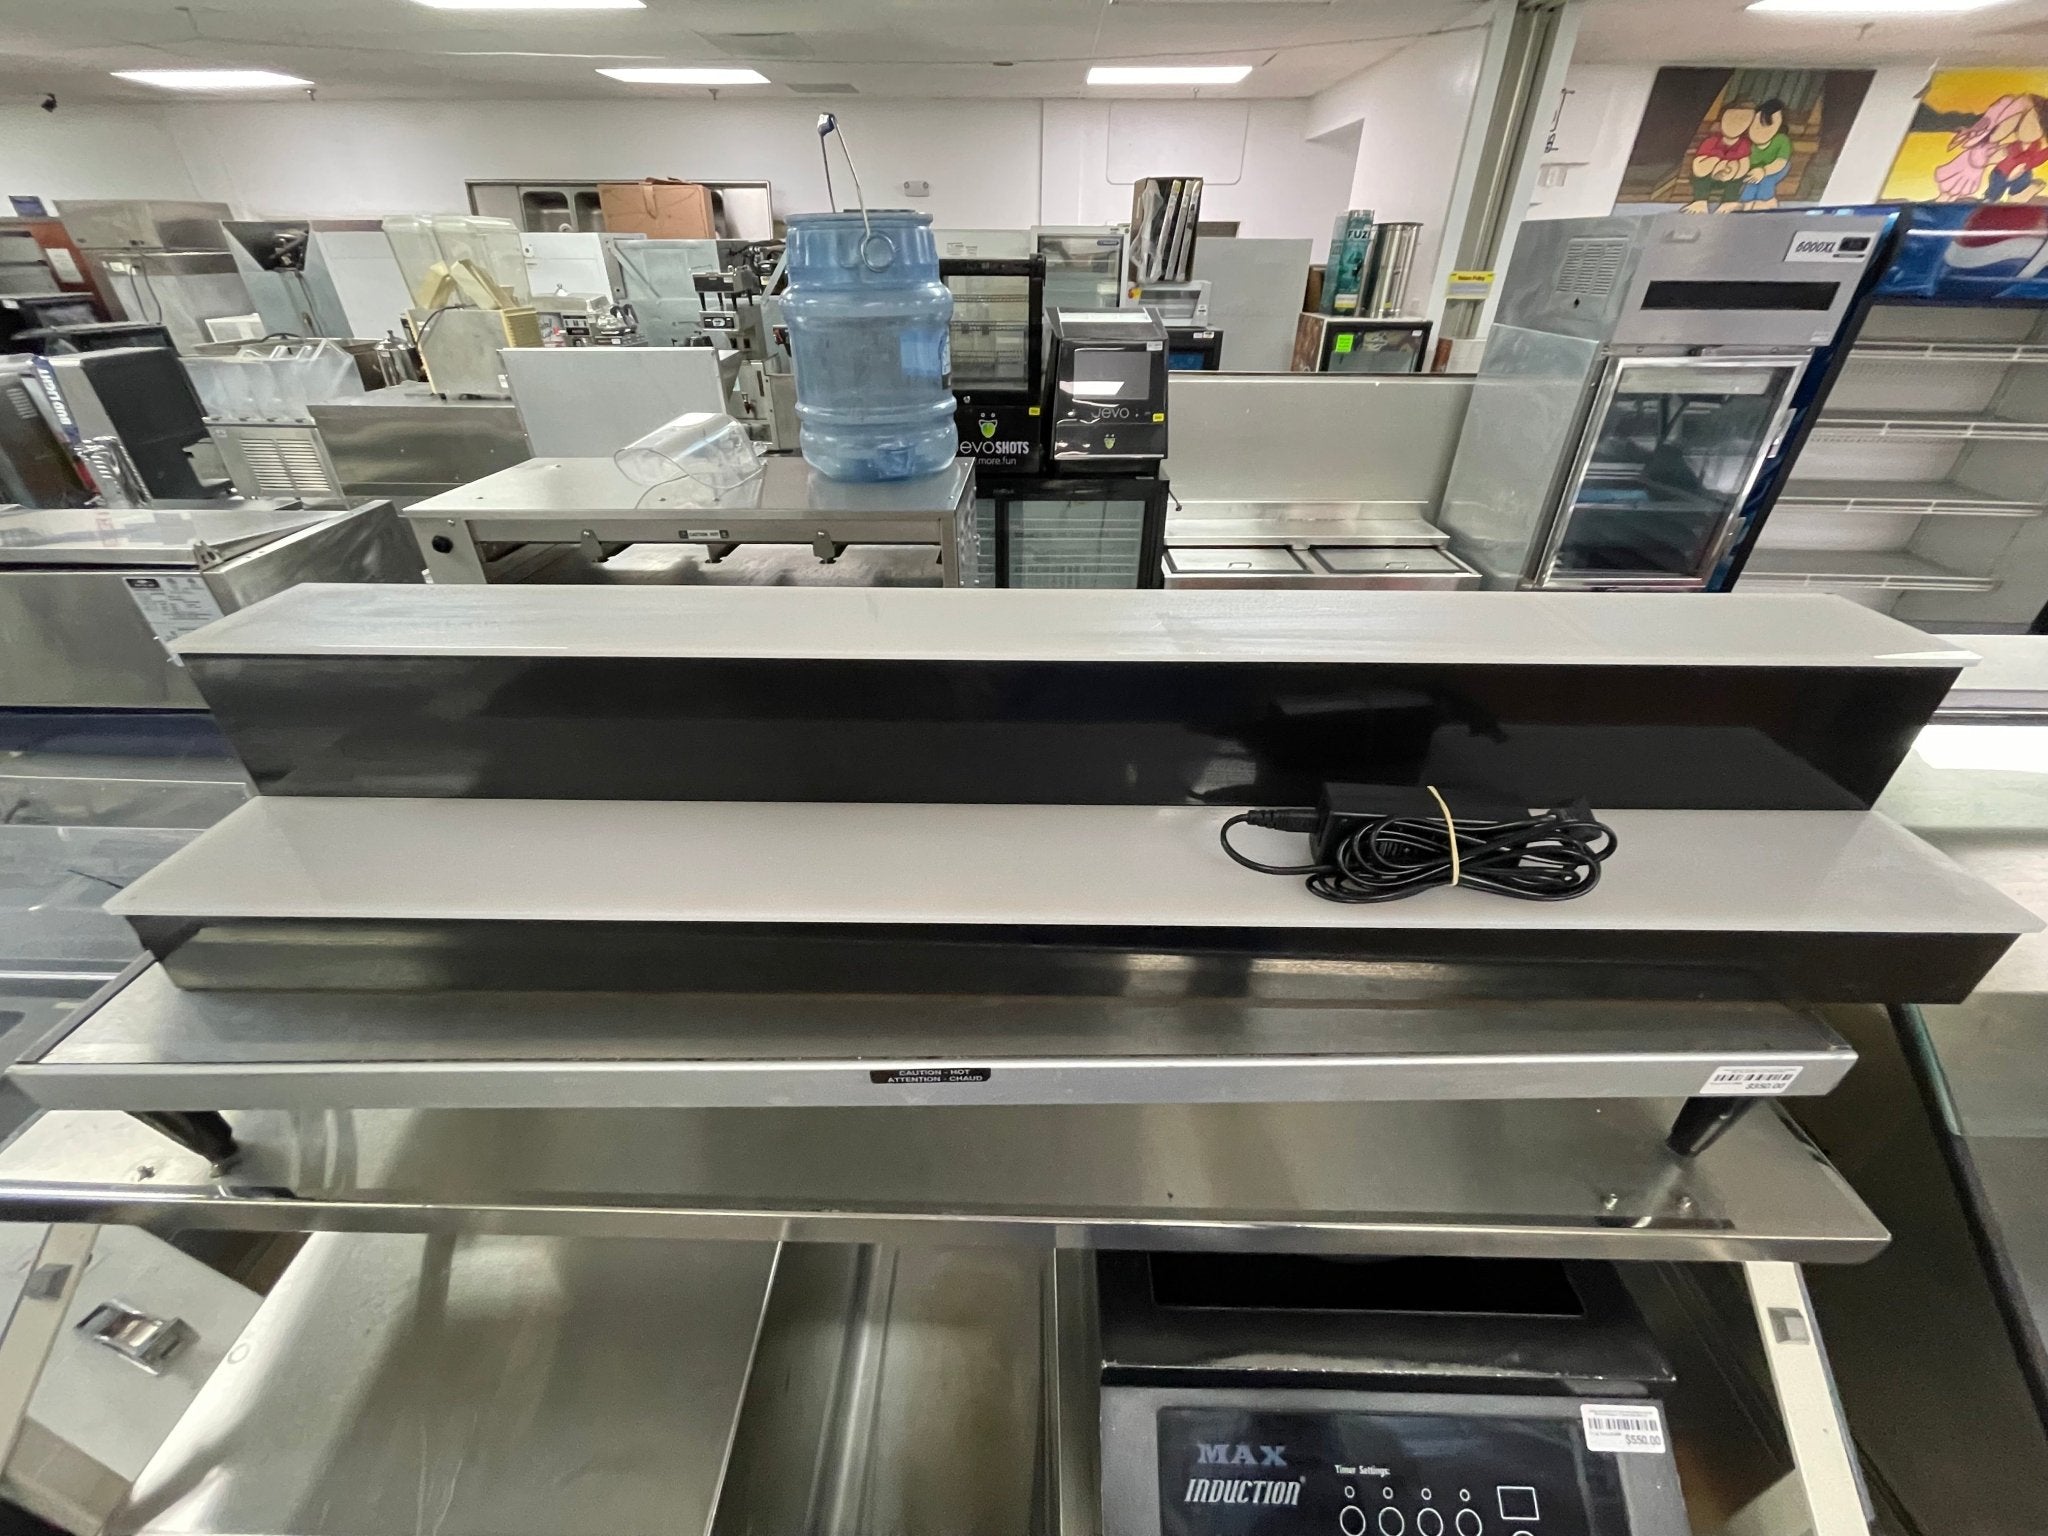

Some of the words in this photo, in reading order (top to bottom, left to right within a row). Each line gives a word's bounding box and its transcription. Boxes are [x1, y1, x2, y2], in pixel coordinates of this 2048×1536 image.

[1346, 230, 1370, 240] FUZ
[1795, 240, 1837, 253] 6000XL
[37, 367, 62, 404] LIGHT
[52, 403, 73, 425] BUD
[959, 440, 1030, 455] evoSHOTS
[1625, 1434, 1662, 1446] $550.00
[1197, 1442, 1288, 1467] MAX
[1334, 1464, 1356, 1474] Timer
[1184, 1478, 1302, 1506] INDUCTION
